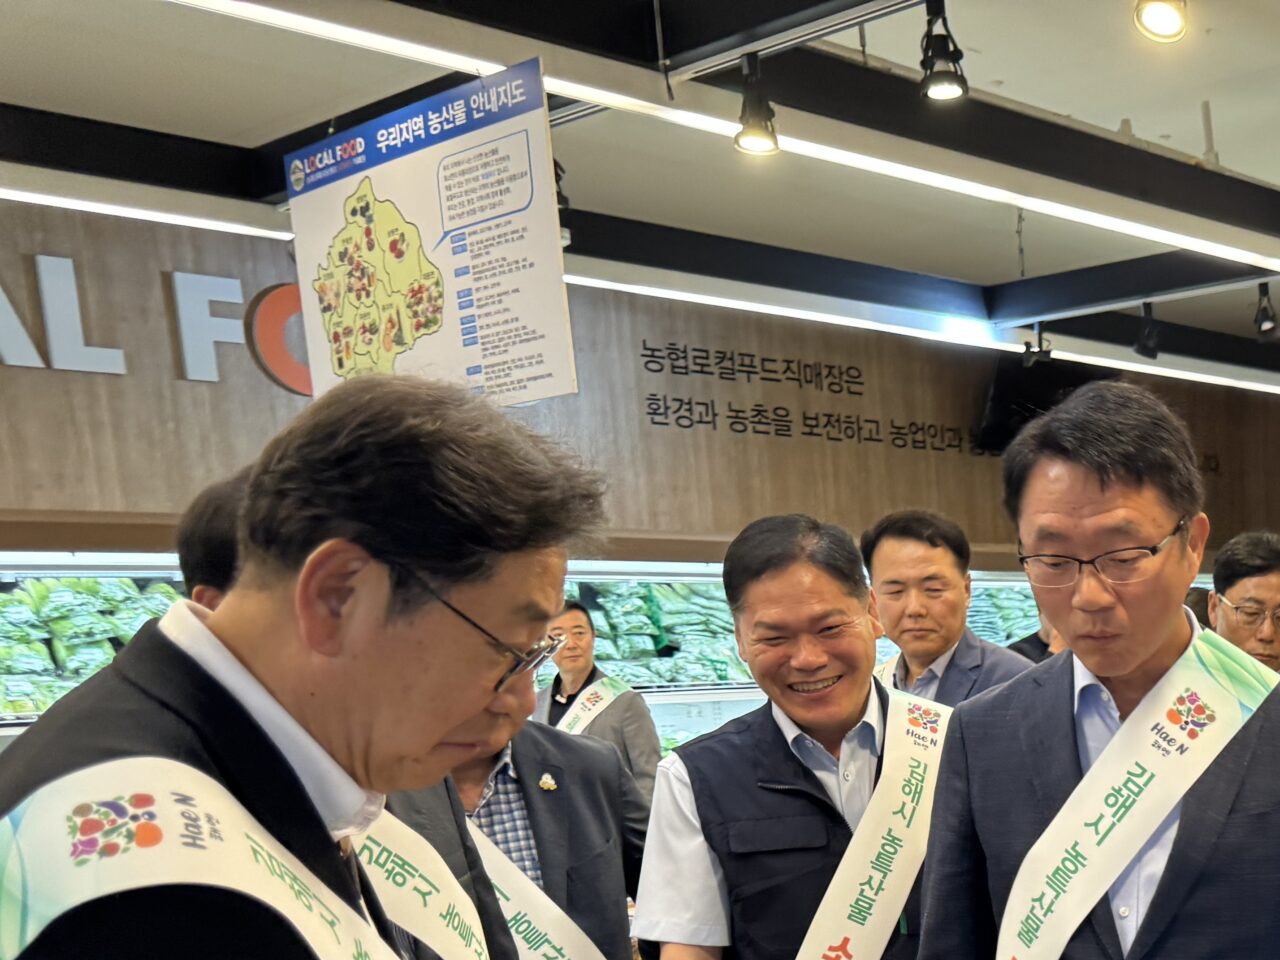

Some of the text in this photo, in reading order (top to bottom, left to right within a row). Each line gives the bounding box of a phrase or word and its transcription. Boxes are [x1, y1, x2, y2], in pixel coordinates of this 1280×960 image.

[376, 79, 527, 153] 우리지역 농산물 안내지도
[304, 149, 334, 173] LOCAL
[336, 137, 365, 163] FOOD
[640, 340, 864, 396] 농협로컬푸드직매장은
[645, 393, 718, 430] 환경과
[726, 401, 793, 438] 농촌을
[801, 410, 884, 444] 보전하고
[889, 419, 963, 454] 농업인과
[906, 728, 929, 743] Hae
[1151, 722, 1189, 755] Hae N
[171, 791, 207, 850] Hae N
[892, 757, 928, 829] 김해시
[1084, 760, 1156, 847] 김해시
[244, 831, 344, 946] 김해시
[357, 834, 441, 908] 김해시
[847, 828, 904, 926] 농특산물
[1017, 840, 1088, 949] 농특산물
